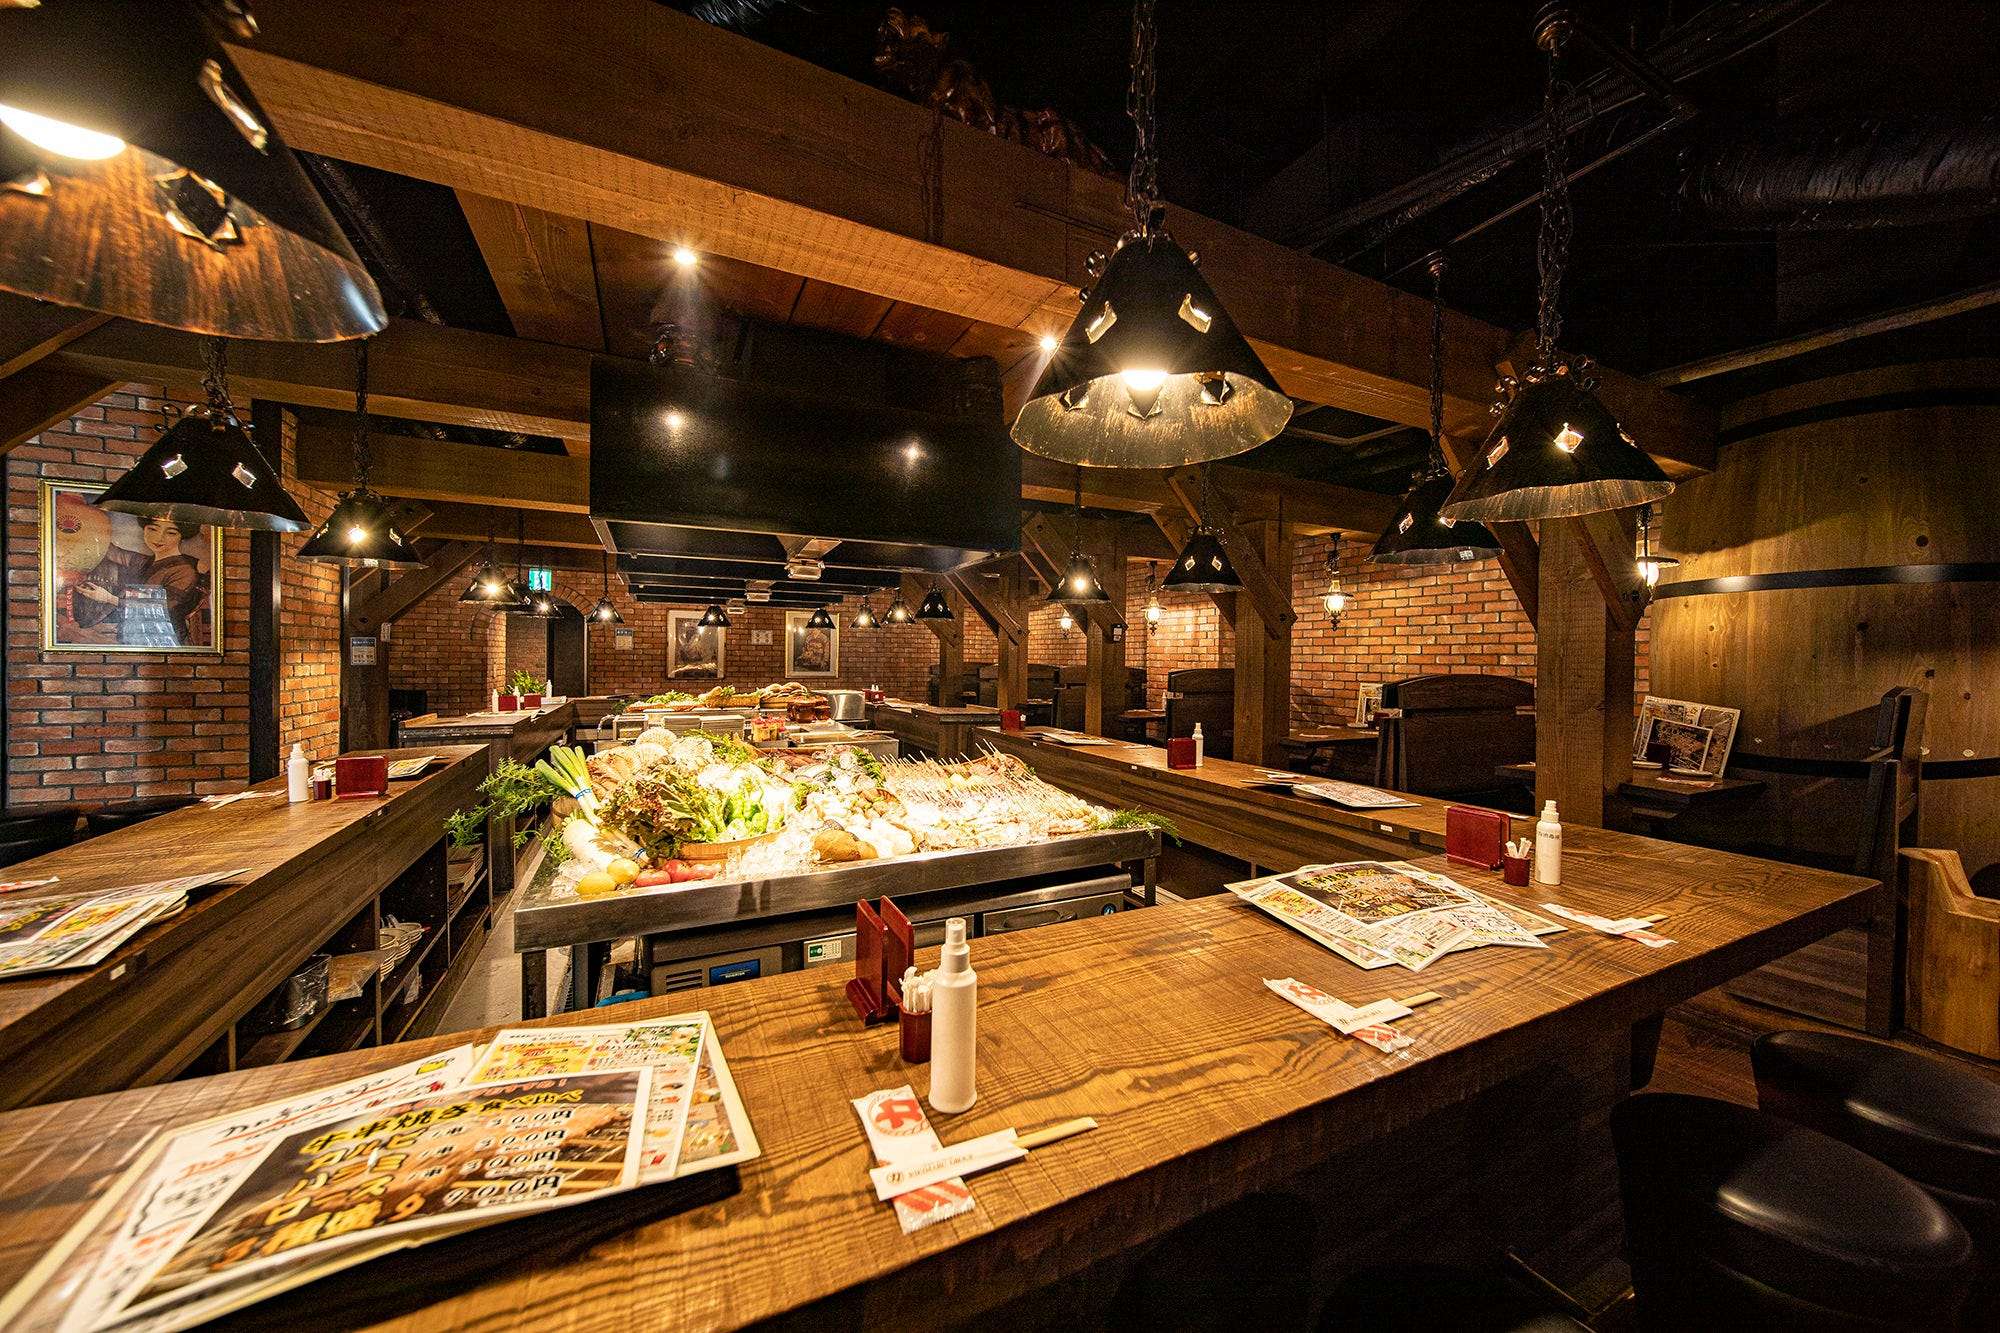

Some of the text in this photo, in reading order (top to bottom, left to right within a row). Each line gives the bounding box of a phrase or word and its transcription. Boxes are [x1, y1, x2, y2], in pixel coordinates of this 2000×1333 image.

[300, 1100, 474, 1154] 牛串焼き
[305, 1128, 428, 1172] カルビ
[264, 1175, 394, 1226] ロース
[460, 1150, 558, 1173] 300円
[282, 1153, 408, 1199] ハラミ
[476, 1129, 566, 1150] 300円
[443, 1173, 562, 1207] 900円
